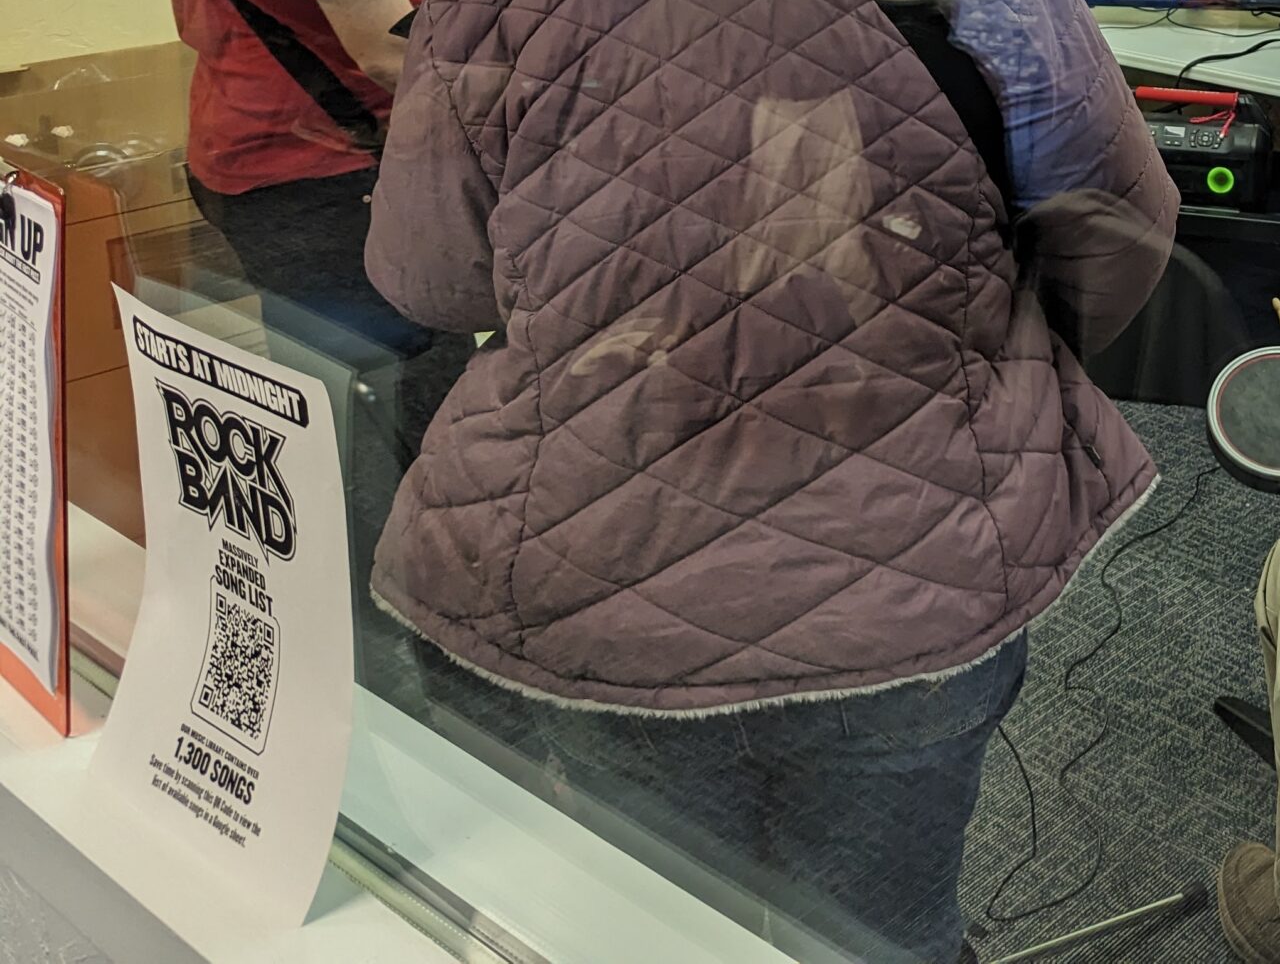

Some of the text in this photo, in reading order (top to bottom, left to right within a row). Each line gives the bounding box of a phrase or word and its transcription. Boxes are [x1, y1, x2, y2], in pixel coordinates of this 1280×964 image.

[20, 214, 44, 266] UP
[136, 321, 300, 422] STARTS AT MIDNIGHT
[155, 377, 295, 520] ROCK
[173, 448, 296, 563] BAND
[219, 549, 266, 591] EXPANDED
[222, 538, 258, 569] MASSIVELY
[215, 564, 273, 617] SONG LIST
[174, 736, 255, 805] 1,300 SONGS
[191, 728, 206, 744] MUSIC
[205, 738, 225, 756] LIBRARY
[225, 751, 247, 772] CONTAINS
[247, 766, 259, 780] OVER
[149, 753, 163, 770] Save
[162, 760, 175, 777] time
[174, 769, 182, 784] by
[181, 775, 204, 799] scanning
[203, 789, 214, 804] this
[220, 800, 234, 817] Code
[232, 811, 240, 822] to
[239, 814, 252, 830] view
[251, 822, 261, 837] the
[161, 781, 169, 792] of
[167, 786, 189, 807] available
[188, 801, 204, 818] songs
[212, 815, 230, 836] Google
